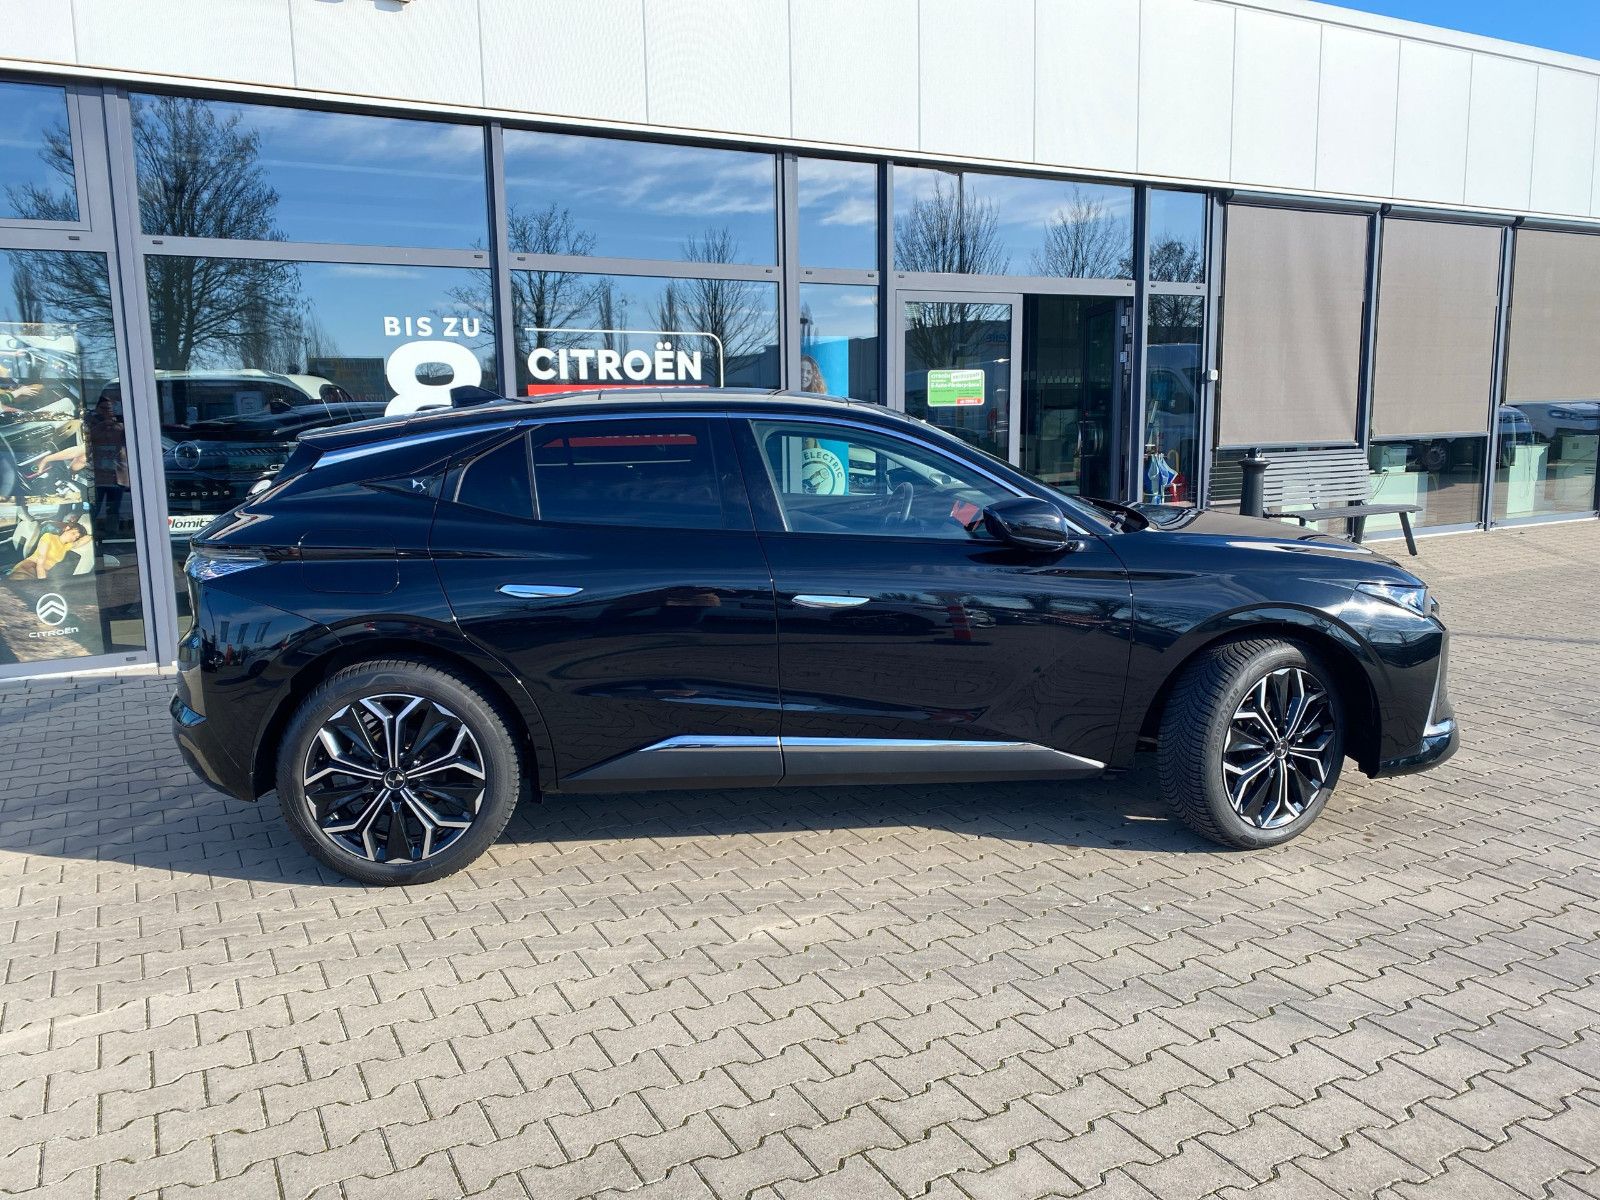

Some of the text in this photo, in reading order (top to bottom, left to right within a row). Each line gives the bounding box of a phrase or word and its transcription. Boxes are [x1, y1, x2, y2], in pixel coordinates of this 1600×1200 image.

[383, 316, 480, 337] BIS ZU
[527, 341, 702, 381] CITROËN
[384, 340, 482, 417] 8
[803, 451, 843, 479] ELECTRIC
